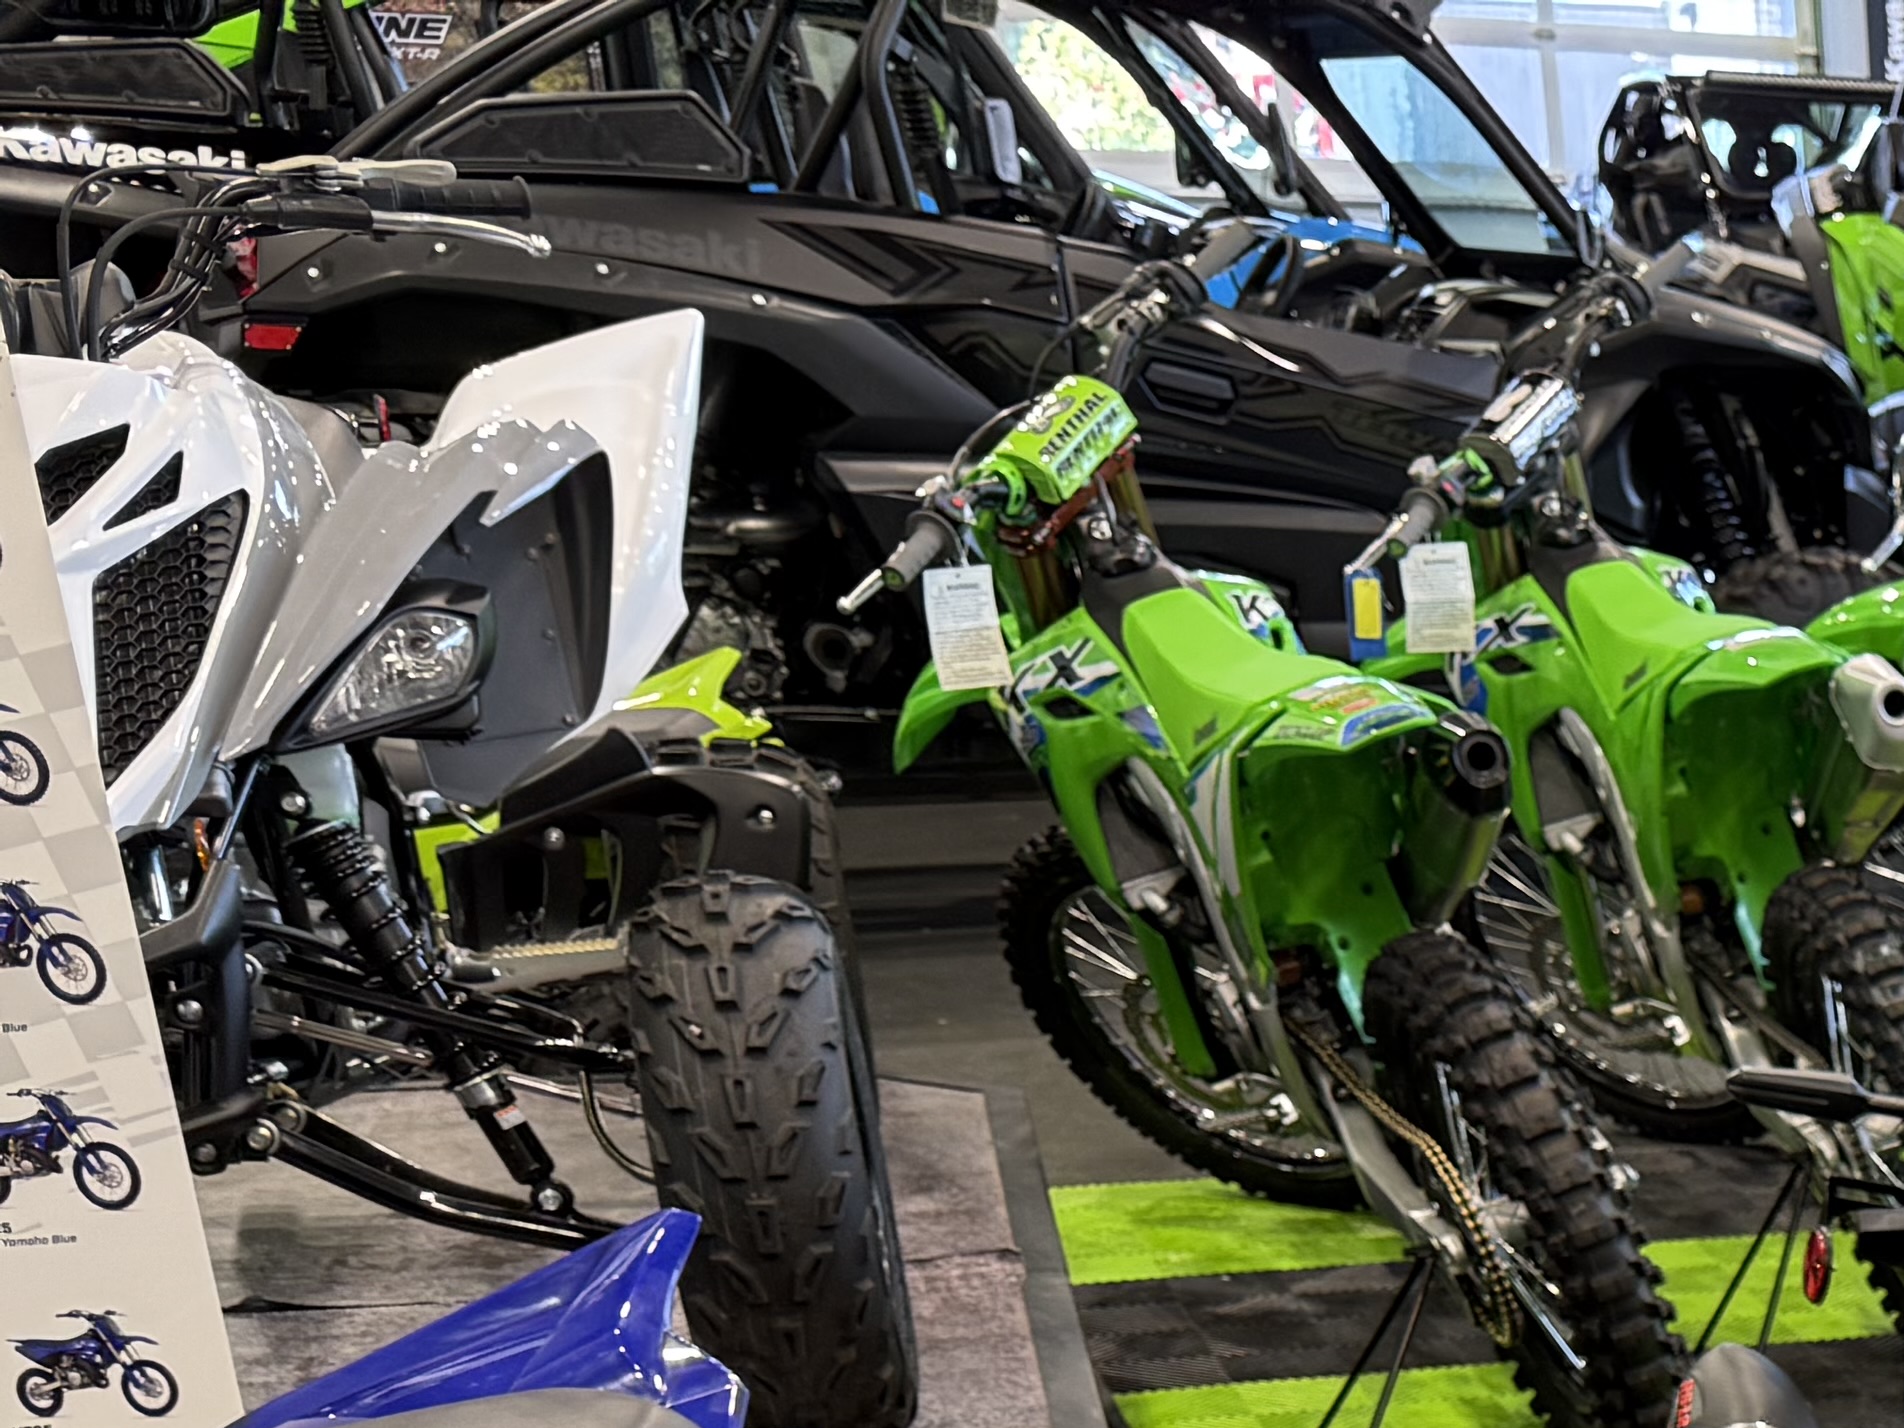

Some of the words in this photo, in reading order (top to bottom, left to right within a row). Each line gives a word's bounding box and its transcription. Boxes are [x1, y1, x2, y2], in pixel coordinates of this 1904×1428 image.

[1040, 391, 1107, 457] RENTHAL
[2, 1022, 28, 1033] Blue
[52, 1234, 77, 1245] Blue
